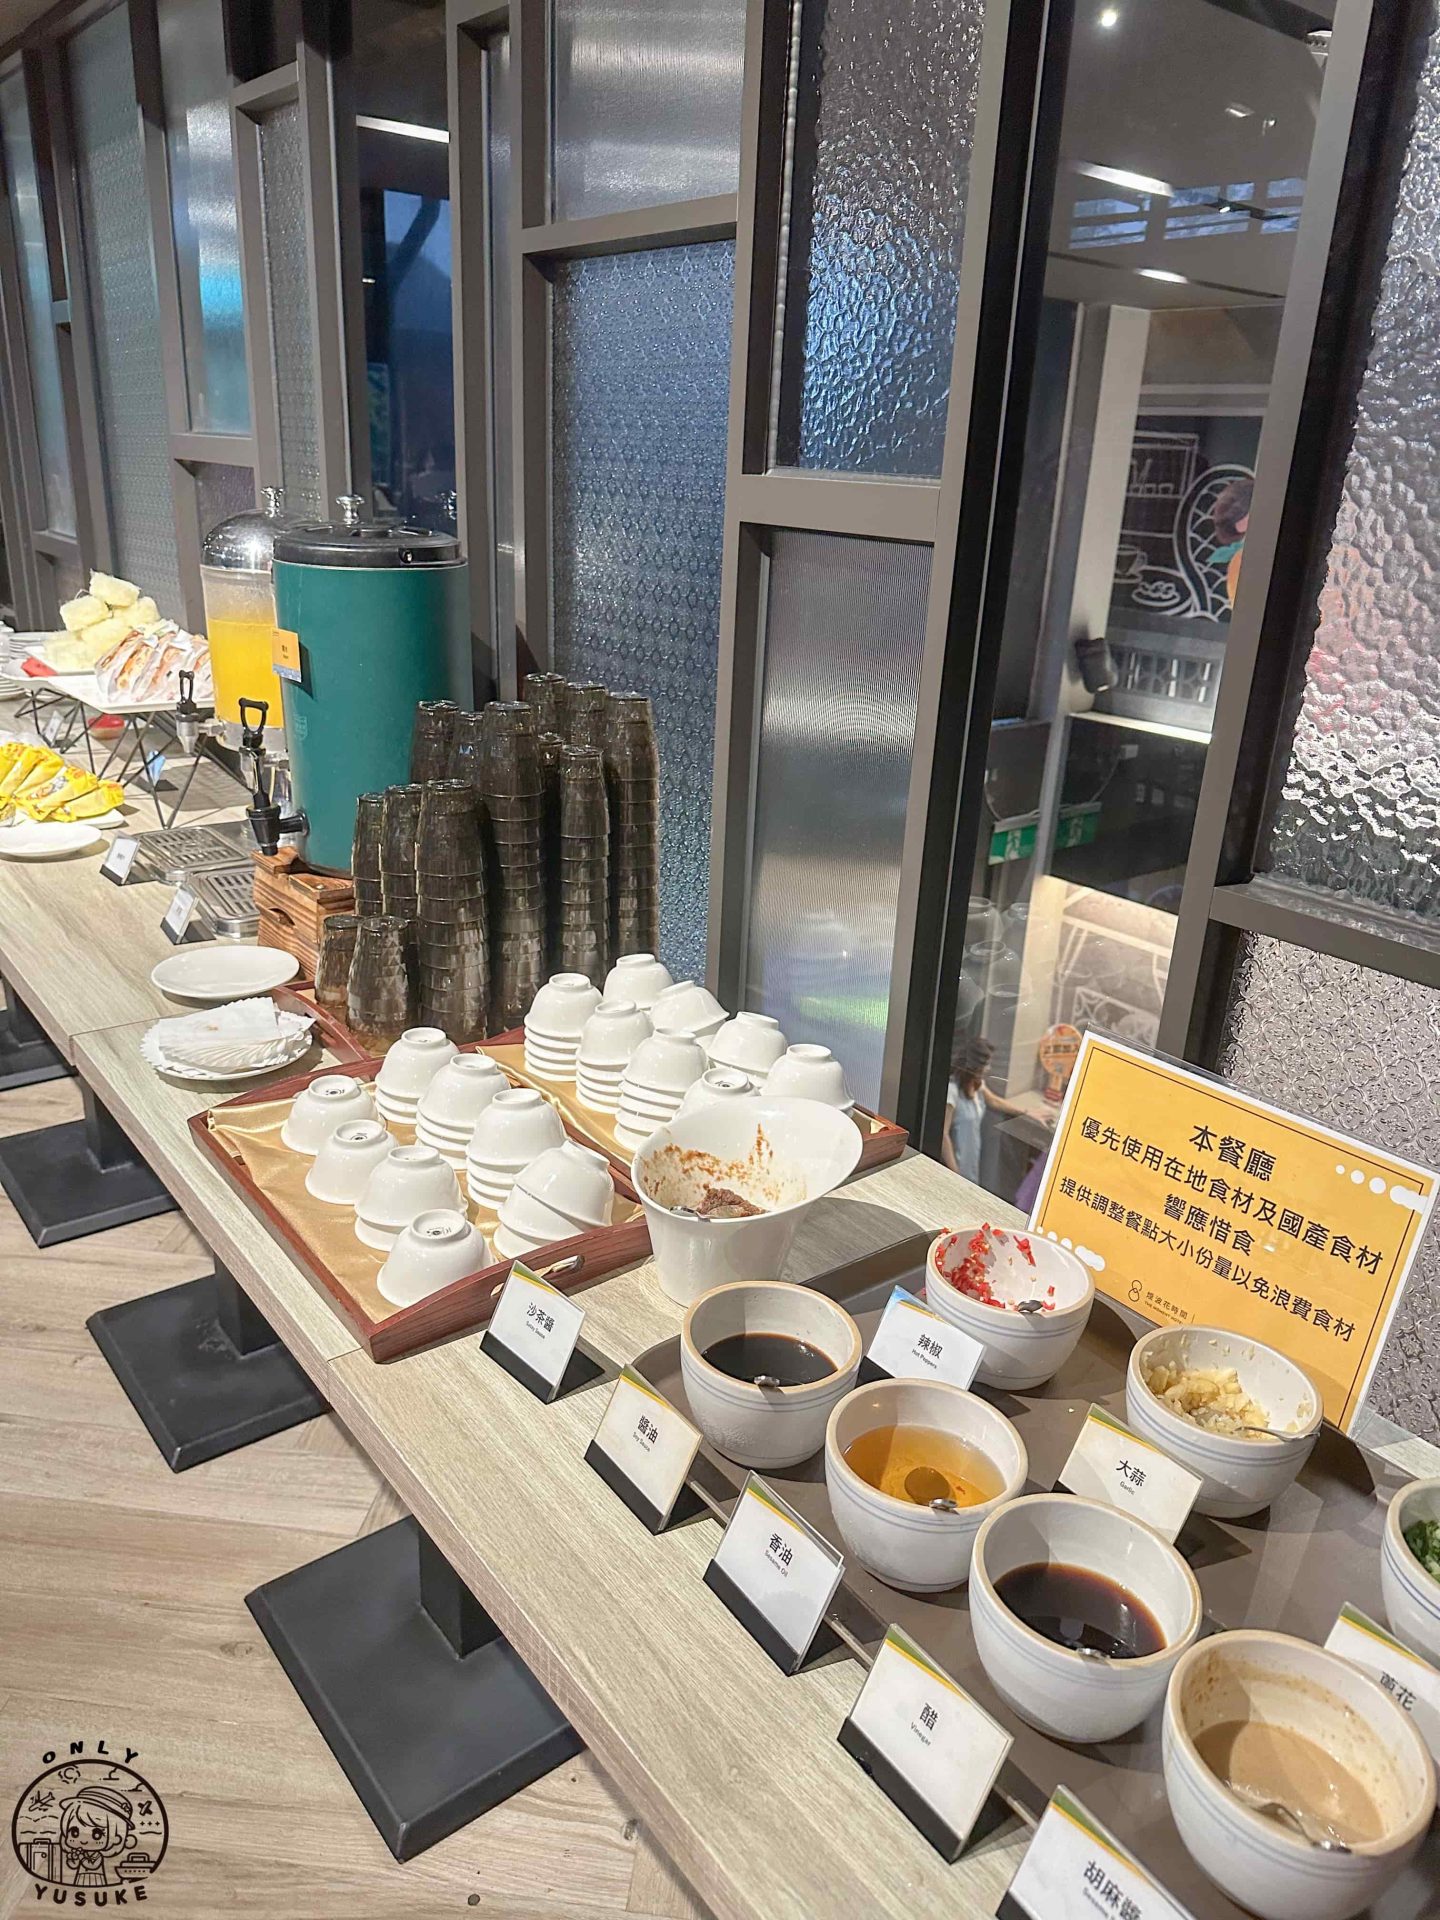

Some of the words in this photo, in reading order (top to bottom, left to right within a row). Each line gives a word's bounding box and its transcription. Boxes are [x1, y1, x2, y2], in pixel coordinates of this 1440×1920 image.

[1189, 1125, 1277, 1182] 本餐廳
[1081, 1116, 1383, 1275] 優先使用在地食材及國產食材
[1163, 1193, 1255, 1256] 響應惜食
[1059, 1176, 1355, 1342] 提供調整餐點大小份量以免浪費食材
[527, 1302, 554, 1332] 沙茶醬
[918, 1333, 943, 1358] 辣椒
[638, 1414, 659, 1444] 醬油
[1115, 1460, 1147, 1487] 大蒜
[1119, 1480, 1135, 1495] Garlic
[770, 1533, 793, 1566] 香油
[920, 1702, 939, 1731] 醋
[910, 1721, 931, 1746] Vinegar
